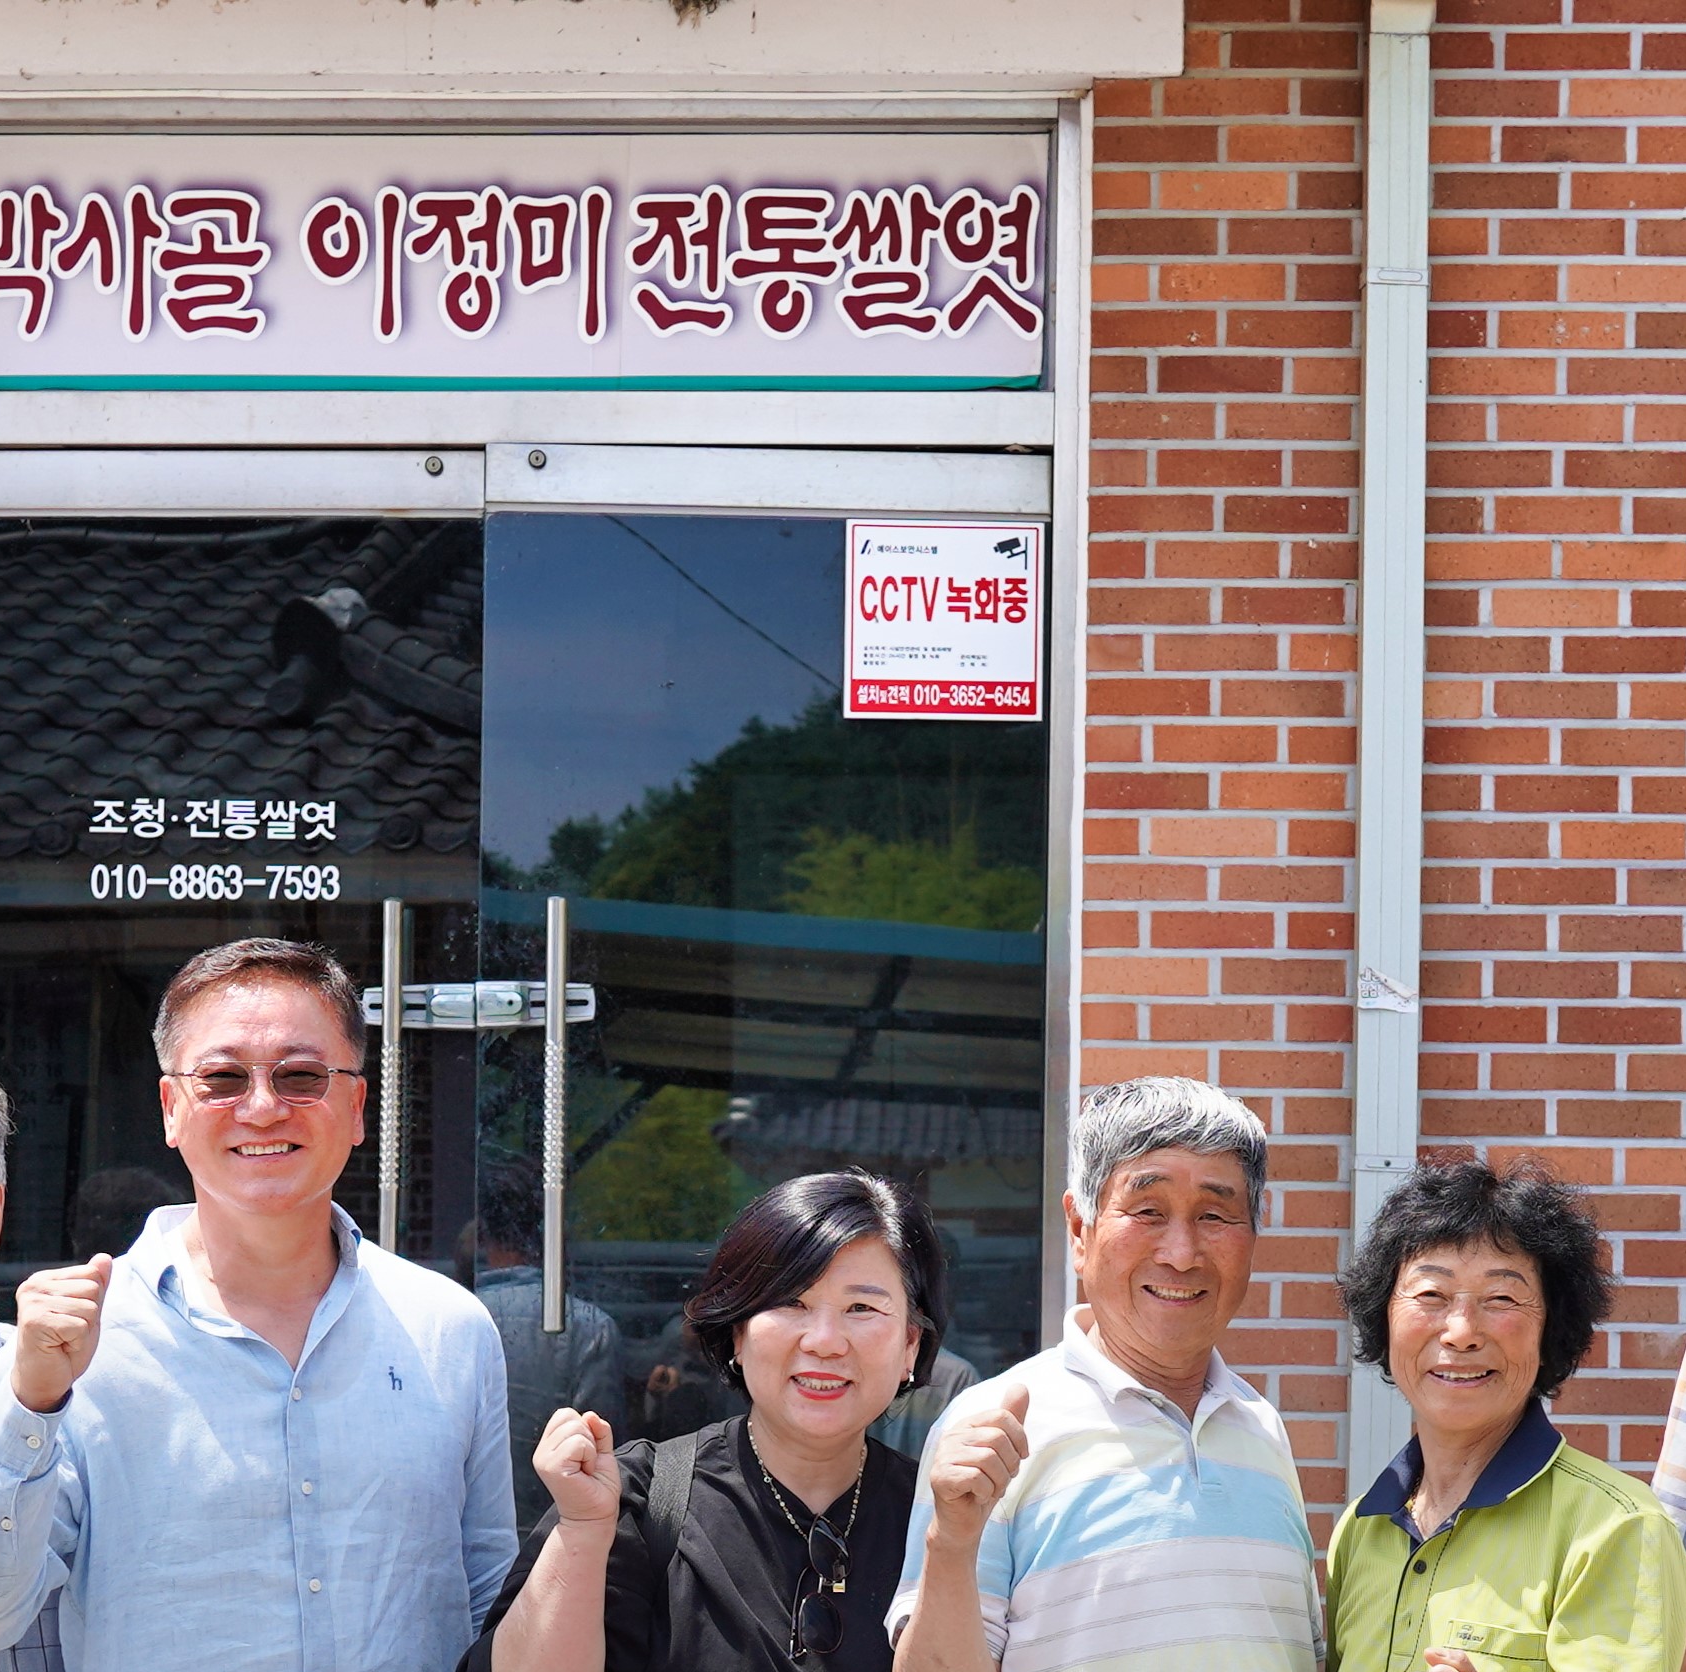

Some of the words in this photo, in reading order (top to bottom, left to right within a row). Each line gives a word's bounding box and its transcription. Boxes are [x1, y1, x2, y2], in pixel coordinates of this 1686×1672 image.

[304, 190, 609, 340] 이정미
[630, 188, 1041, 338] 전통쌀엿
[860, 575, 940, 623] CCTV
[946, 577, 1029, 624] 녹화중
[913, 684, 1031, 708] 010-3652-6454
[91, 865, 341, 902] 010-8863-7593
